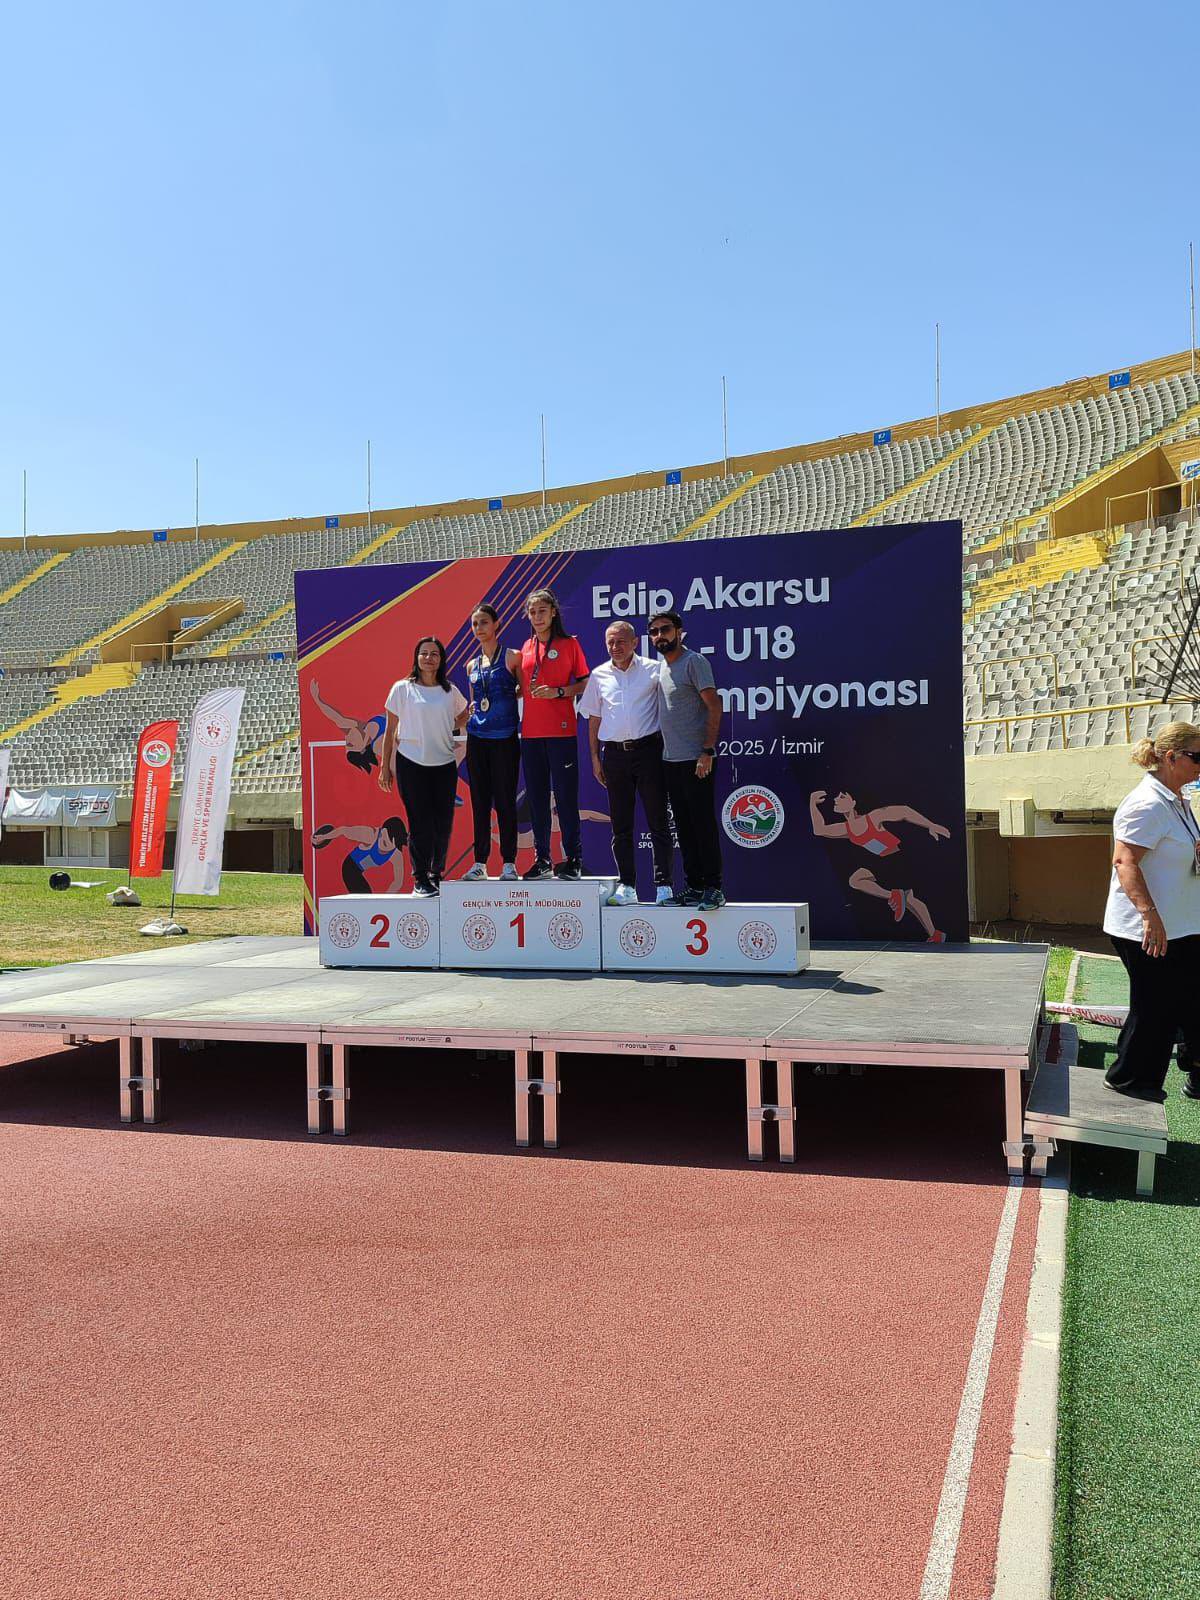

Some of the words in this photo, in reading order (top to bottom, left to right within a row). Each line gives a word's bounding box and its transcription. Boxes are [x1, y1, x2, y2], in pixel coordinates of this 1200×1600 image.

[592, 583, 674, 618] Edip
[683, 575, 830, 612] Akarsu
[725, 625, 796, 662] U18
[716, 676, 929, 720] mpiyonası
[718, 739, 765, 756] 2025
[769, 738, 778, 755] /
[782, 735, 825, 755] İzmir
[205, 755, 217, 795] BAKANLIĞI
[202, 817, 209, 827] VE
[203, 797, 212, 816] SPOR
[198, 830, 208, 861] GENÇLİK
[462, 899, 491, 909] GENÇLİK
[494, 900, 503, 908] VE
[505, 900, 524, 908] SPOR
[526, 899, 532, 907] İL
[535, 899, 581, 908] MÜDÜRLÜĞÜ
[509, 890, 529, 898] İZMİR
[370, 914, 390, 948] 2
[509, 912, 525, 948] 1
[685, 918, 709, 956] 3
